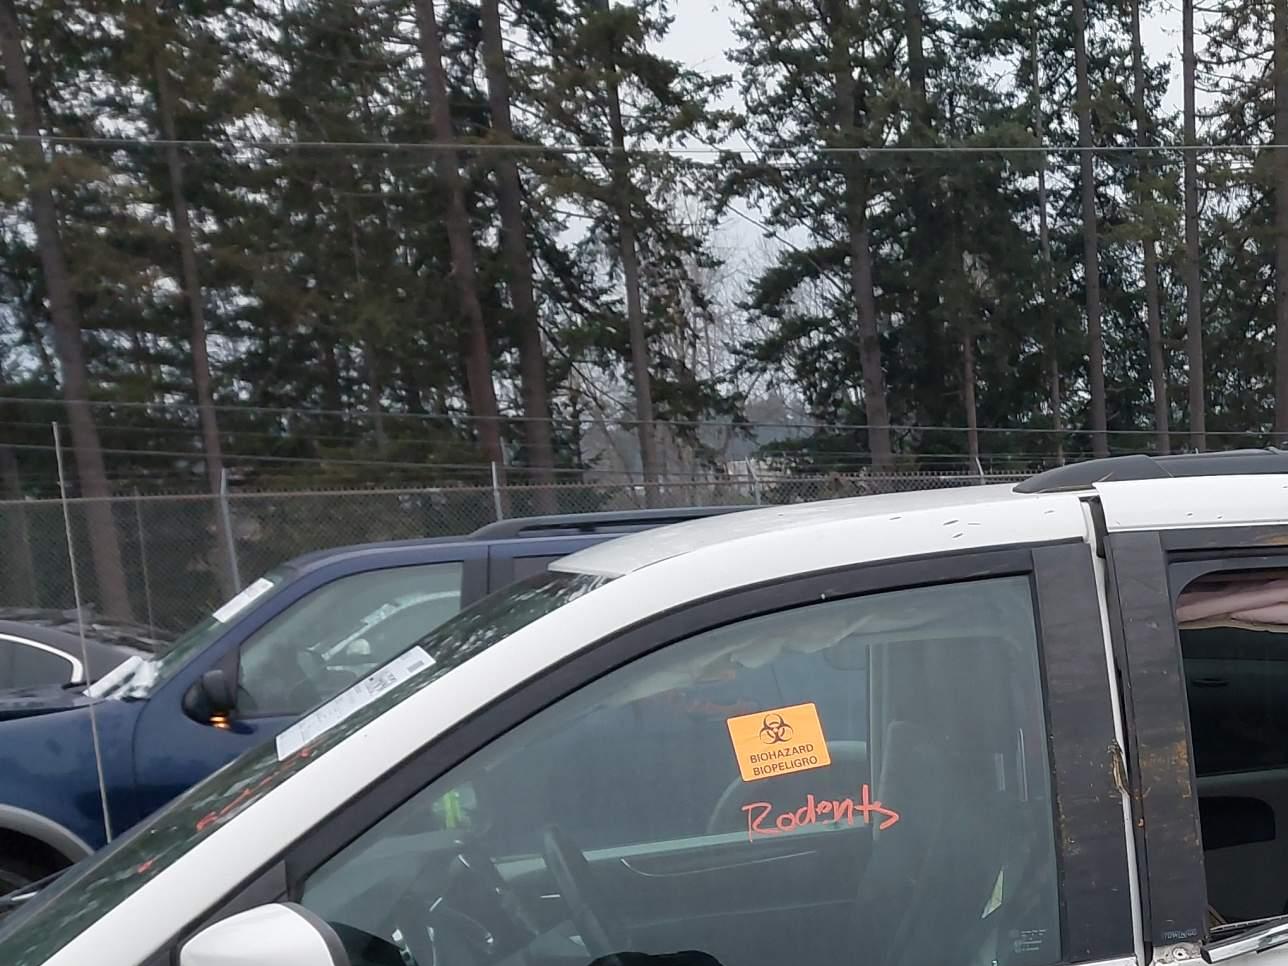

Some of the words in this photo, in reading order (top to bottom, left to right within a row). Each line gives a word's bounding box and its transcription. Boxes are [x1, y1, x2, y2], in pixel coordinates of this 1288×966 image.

[749, 743, 814, 764] BIOHAZARD
[752, 755, 818, 776] BIOPELIGRO
[741, 784, 900, 843] Rodents
